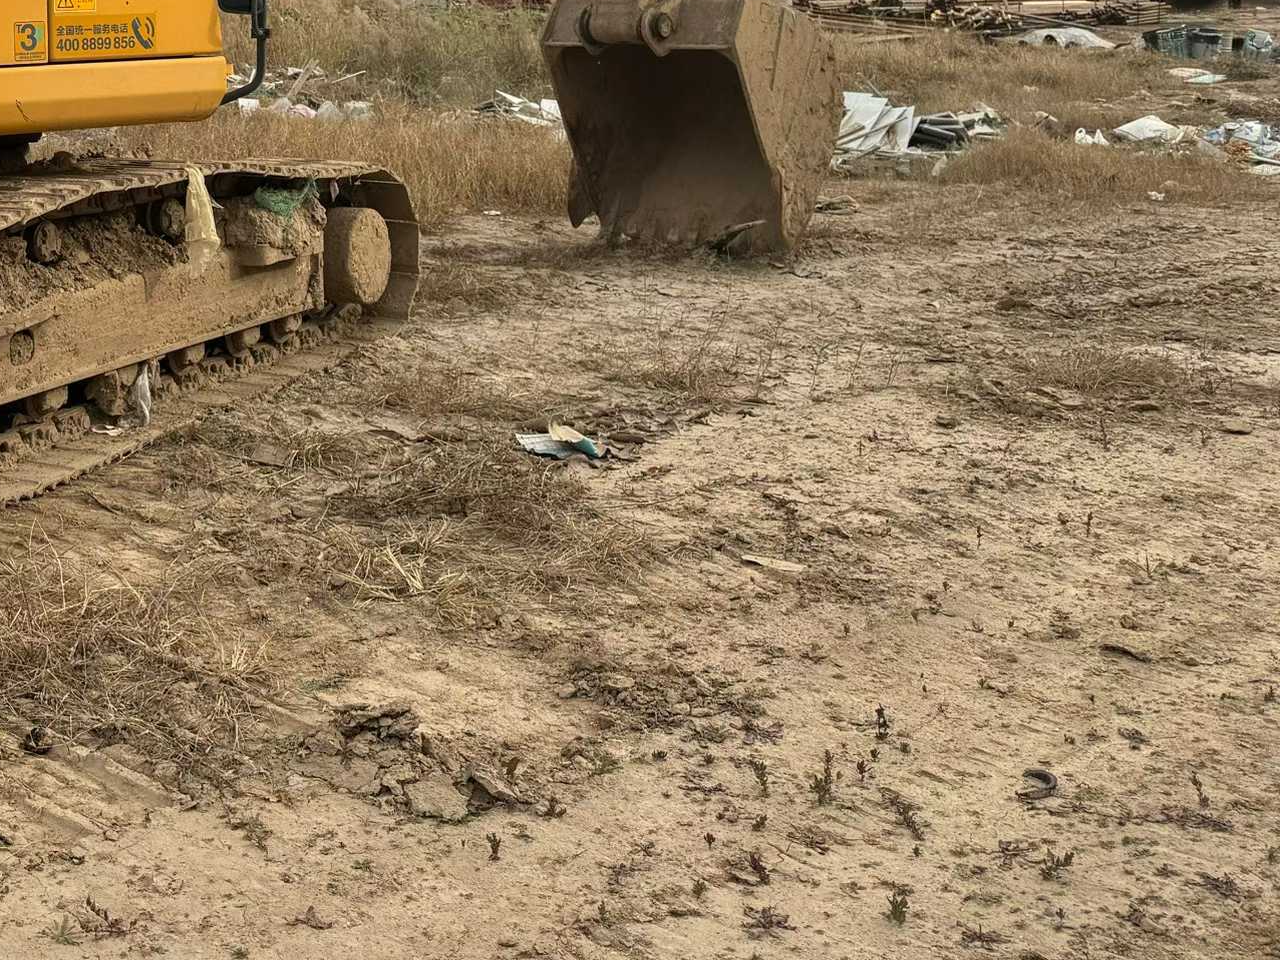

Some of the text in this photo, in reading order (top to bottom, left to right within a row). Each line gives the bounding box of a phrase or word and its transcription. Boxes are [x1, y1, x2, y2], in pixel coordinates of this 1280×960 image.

[56, 23, 128, 36] 全国统一服务电话
[56, 36, 135, 51] 400 8899 856
